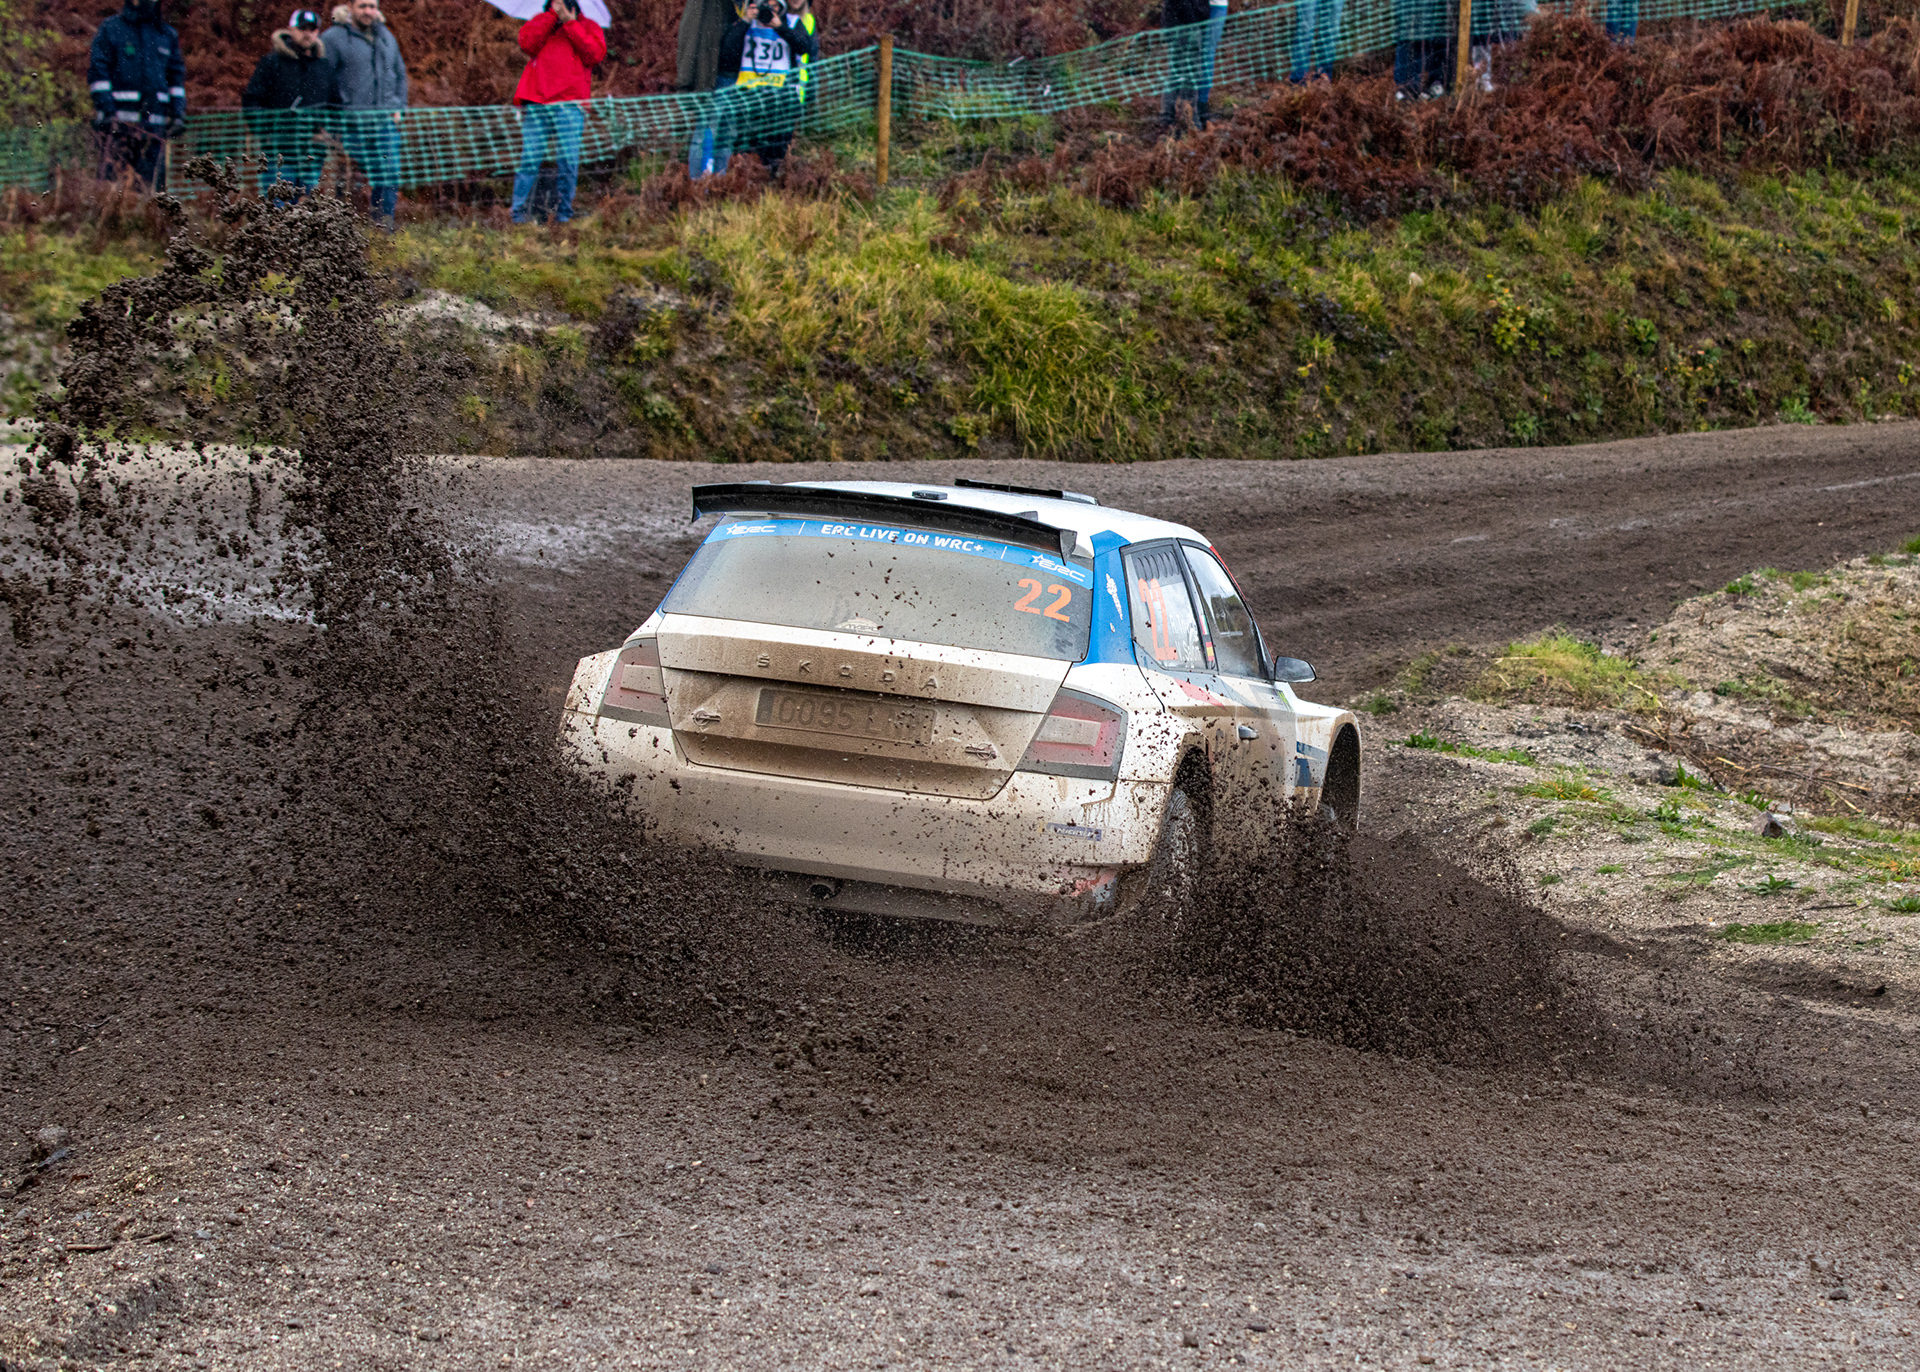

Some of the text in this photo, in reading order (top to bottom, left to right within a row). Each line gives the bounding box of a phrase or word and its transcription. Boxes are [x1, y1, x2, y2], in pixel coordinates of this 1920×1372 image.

[821, 524, 984, 551] ERC LIVE ON WRC+
[1014, 578, 1072, 623] 22
[778, 695, 856, 730] 0095
